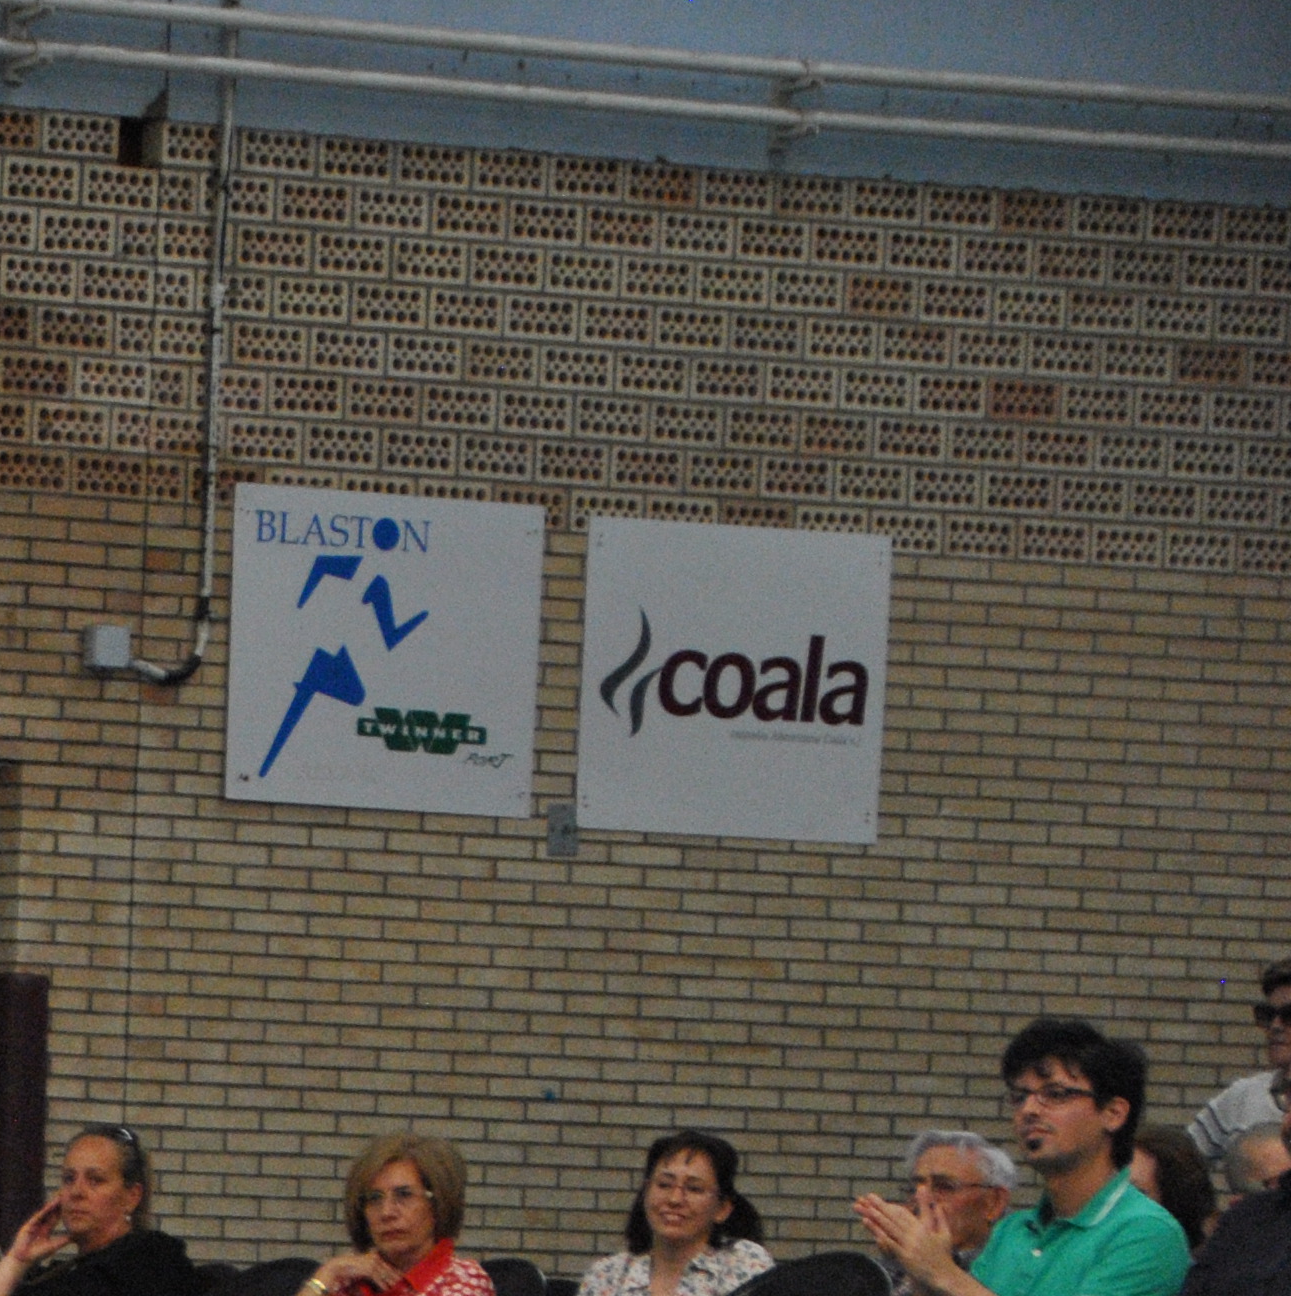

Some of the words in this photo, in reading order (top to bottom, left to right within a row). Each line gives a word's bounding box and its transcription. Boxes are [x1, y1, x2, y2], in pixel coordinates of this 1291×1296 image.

[255, 508, 431, 553] BLASTON
[658, 634, 868, 726] coala
[362, 722, 481, 743] TWINNER
